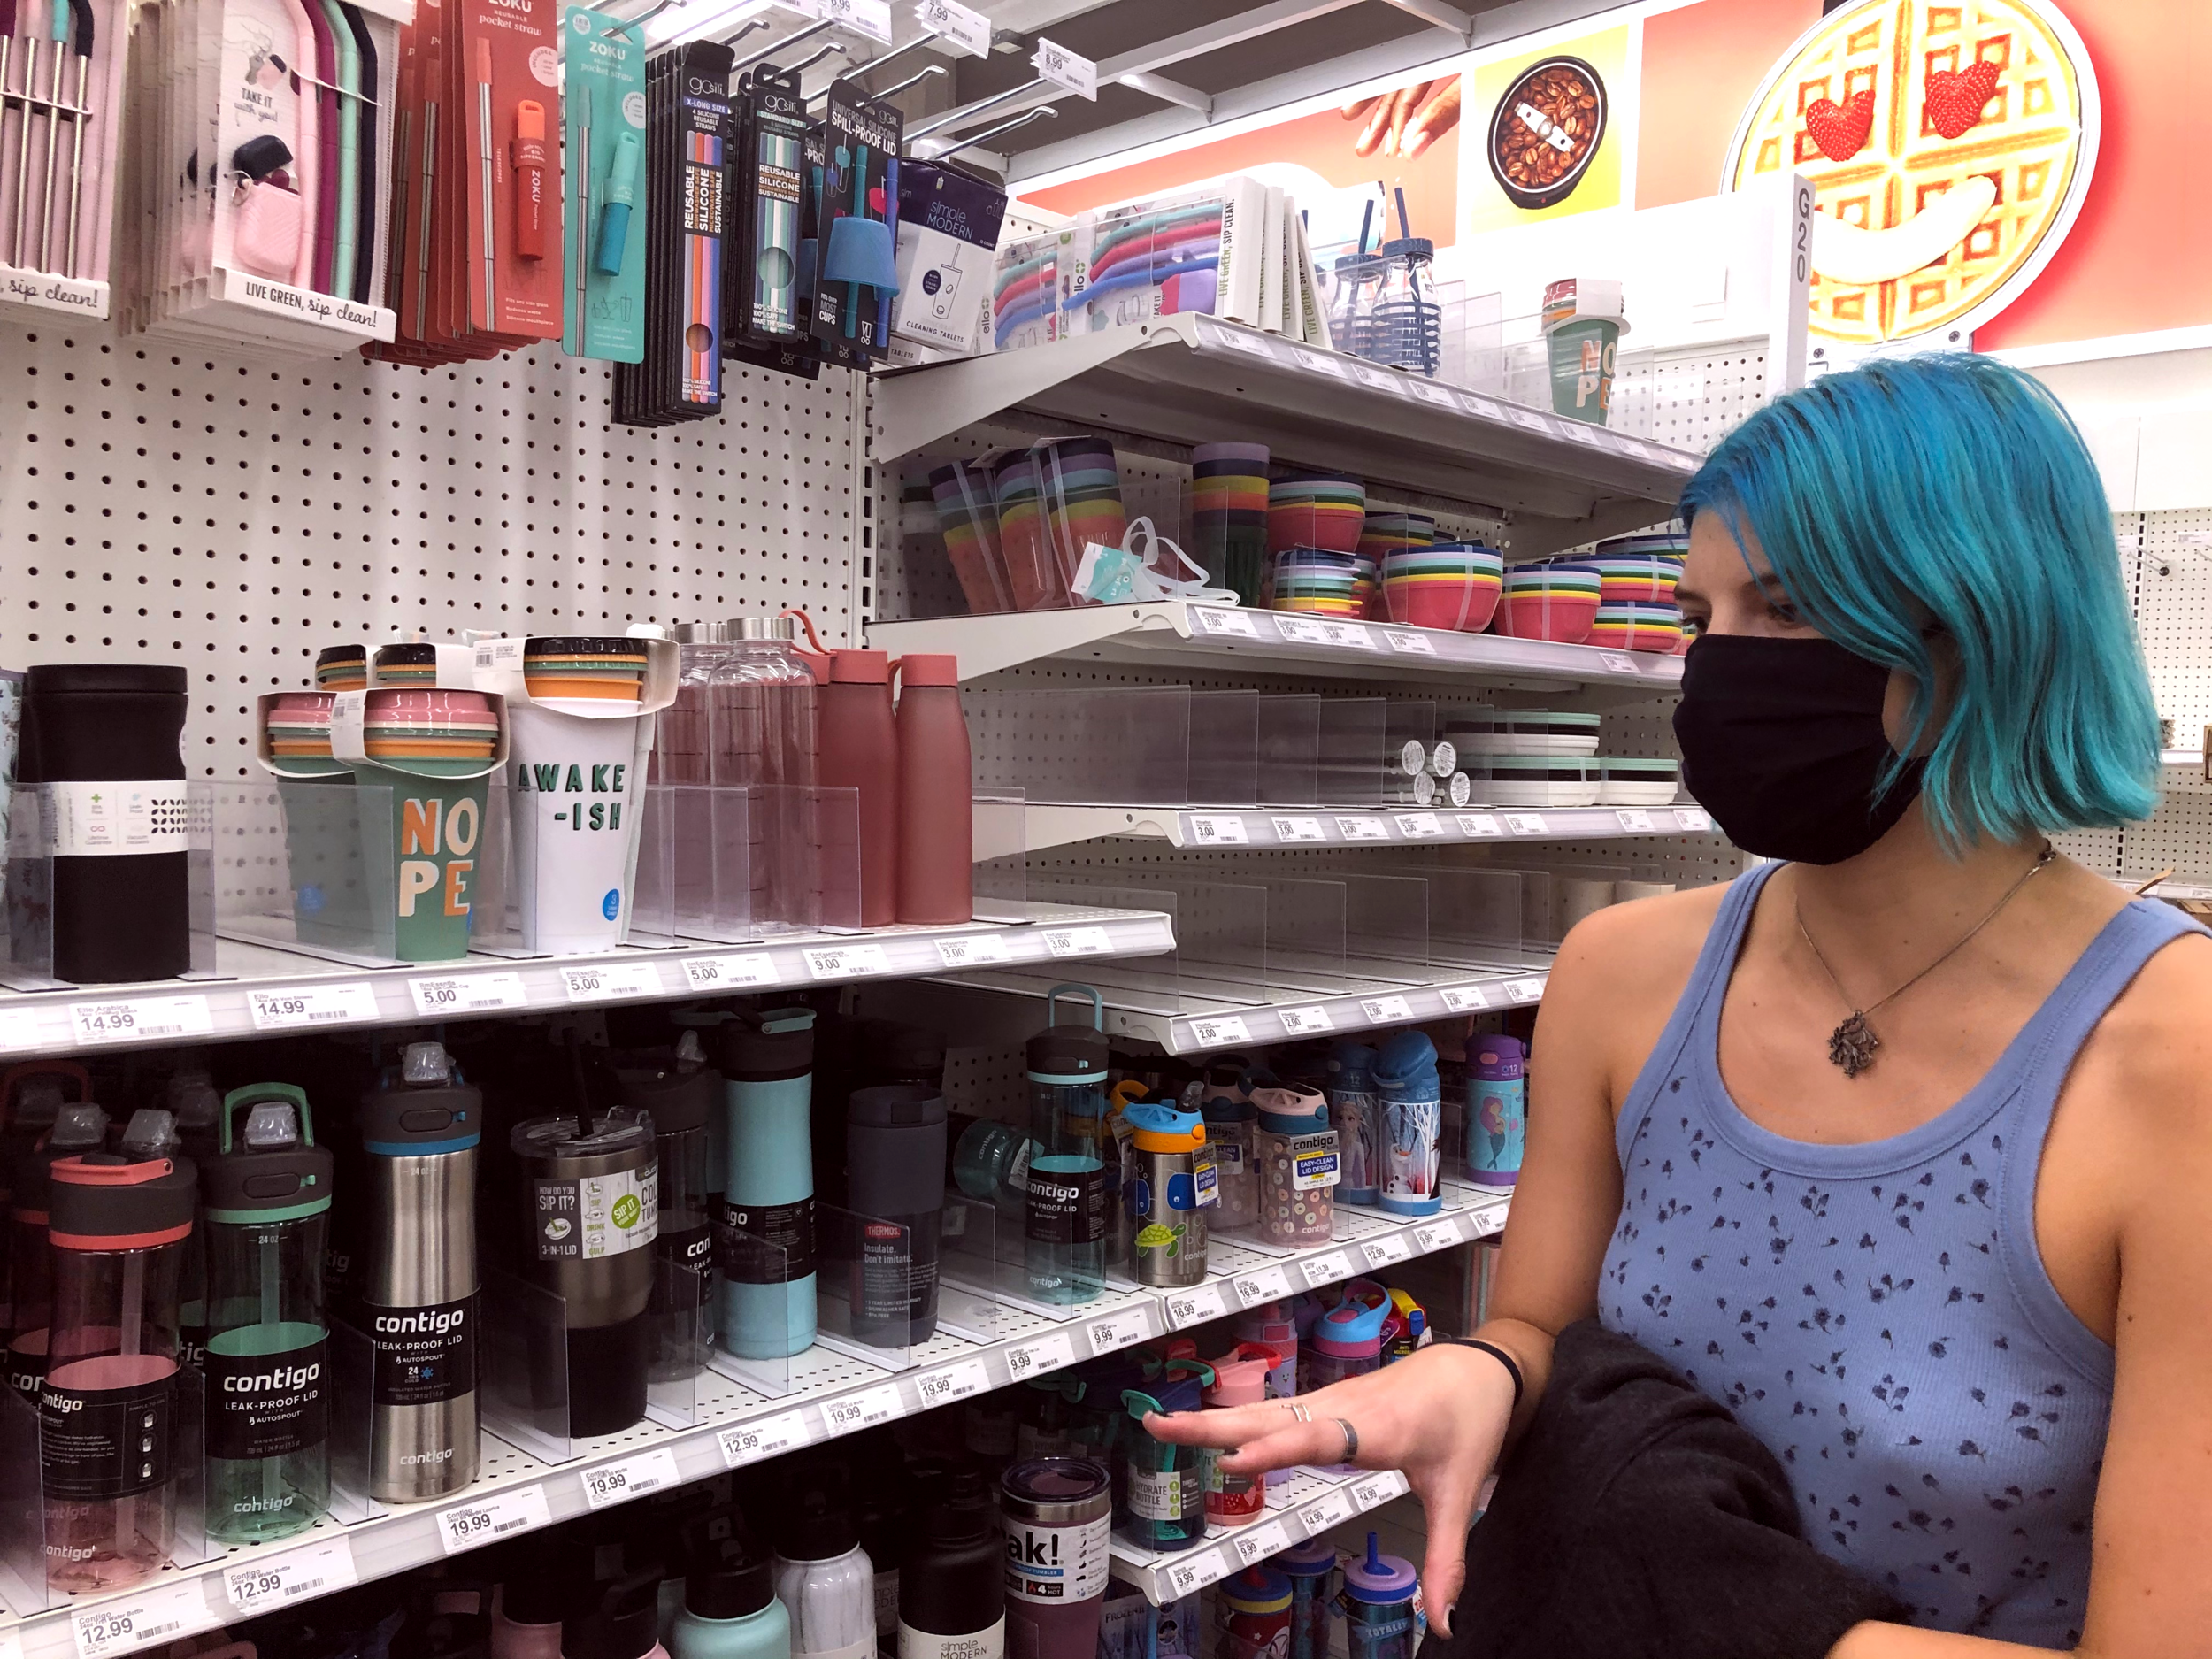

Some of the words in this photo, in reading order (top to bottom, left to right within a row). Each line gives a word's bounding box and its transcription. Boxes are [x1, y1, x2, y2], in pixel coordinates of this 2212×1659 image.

[929, 3, 948, 22] 7.99
[480, 14, 511, 29] pocket
[514, 24, 542, 36] straw
[589, 41, 626, 60] ZOKU
[1046, 53, 1062, 70] 8.99
[580, 62, 608, 76] pocket
[242, 88, 262, 104] TAKE
[265, 96, 273, 109] IT
[687, 99, 710, 111] X-LONG
[712, 104, 725, 112] SIZE
[694, 116, 718, 126] REUSABLE
[697, 111, 719, 119] SILICONE
[760, 111, 789, 124] STANDARD
[833, 100, 867, 127] UNIVERSAL
[868, 119, 896, 142] SILICONE
[695, 122, 716, 131] STRAWS
[832, 111, 881, 148] SPILL-PROOF
[883, 139, 896, 156] LID
[759, 164, 800, 180] REUSABLE
[759, 177, 800, 192] SILICONE
[685, 165, 695, 228] REUSABLE
[699, 169, 709, 231] SILICONE
[758, 189, 799, 203] SUSTAINABLE
[931, 201, 966, 222] simple
[1224, 198, 1235, 229] CLEAN.
[927, 214, 972, 240] MODERN
[1223, 231, 1233, 244] SIP
[1797, 188, 1809, 283] G20
[1220, 246, 1232, 277] GREEN,
[10, 279, 36, 299] sip
[45, 284, 98, 308] clean!
[1218, 280, 1228, 296] LIVE
[246, 281, 267, 299] LIVE
[270, 288, 304, 310] GREEN,
[306, 296, 332, 317] sip
[336, 303, 377, 328] clean!
[820, 301, 836, 314] MOST
[819, 311, 835, 325] CUPS
[907, 320, 937, 335] CLEANING
[941, 331, 964, 342] TABLETS
[1306, 318, 1318, 334] LIVE
[891, 348, 914, 358] TABLETS
[1581, 340, 1617, 375] NO
[1577, 375, 1612, 410] PE
[1204, 618, 1222, 627] 3.00
[1280, 626, 1297, 635] 3.00
[1325, 630, 1342, 639] 3.00
[519, 764, 625, 793] AWAKE
[555, 803, 621, 831] -ISH
[402, 797, 479, 856] NO
[1198, 826, 1215, 836] 3.00
[1279, 826, 1294, 834] 3.00
[1342, 825, 1357, 833] 3.00
[399, 860, 473, 917] PE
[1050, 939, 1070, 948] 3.00
[943, 949, 964, 957] 3.00
[815, 959, 840, 970] 9.00
[691, 968, 718, 979] 5.00
[571, 979, 599, 990] 5.00
[424, 990, 456, 1003] 5.00
[1448, 997, 1462, 1006] 2.00
[258, 1001, 304, 1015] 14.99
[1367, 1008, 1382, 1017] 2.00
[81, 1014, 134, 1030] 14.99
[1286, 1018, 1301, 1027] 2.00
[1199, 1029, 1216, 1038] 2.00
[1294, 1136, 1333, 1150] contigo
[1301, 1157, 1334, 1168] EASY-CLEAN
[1312, 1164, 1333, 1173] DESIGN
[540, 1196, 556, 1210] SIP
[559, 1195, 575, 1210] IT?
[613, 1205, 626, 1220] SIP
[627, 1198, 635, 1209] IT
[1477, 1218, 1489, 1227] 9.99
[1420, 1234, 1433, 1244] 9.99
[565, 1245, 577, 1255] LID
[1368, 1248, 1385, 1259] 12.99
[1240, 1286, 1260, 1297] 16.99
[1174, 1304, 1194, 1317] 16.99
[376, 1310, 464, 1334] contigo
[378, 1340, 443, 1350] LEAK-PROOF
[448, 1335, 462, 1345] LID
[1094, 1330, 1113, 1344] 9.99
[1010, 1356, 1031, 1371] 9.99
[224, 1363, 319, 1392] contigo
[922, 1380, 949, 1397] 19.99
[226, 1395, 300, 1410] LEAK-PROOF
[303, 1390, 318, 1402] LID
[257, 1410, 300, 1423] AUTOSPOUT
[832, 1406, 861, 1423] 19.99
[726, 1435, 758, 1454] 12.99
[400, 1448, 453, 1465] contigo
[590, 1474, 626, 1494] 19.99
[1136, 1484, 1167, 1495] HYDRATE
[1360, 1489, 1377, 1502] 14.99
[234, 1495, 293, 1513] contigo
[450, 1514, 490, 1536] 19.99
[1305, 1512, 1324, 1525] 14.99
[1007, 1532, 1058, 1565] ak!
[1240, 1543, 1257, 1557] 9.99
[231, 1569, 261, 1580] Contigo
[1177, 1572, 1194, 1586] 9.99
[234, 1574, 280, 1600] 12.99
[1038, 1585, 1046, 1594] 4
[79, 1612, 111, 1624] Contigo
[83, 1618, 132, 1643] 12.99
[1366, 1621, 1408, 1638] TOTALLY
[941, 1640, 978, 1652] simple
